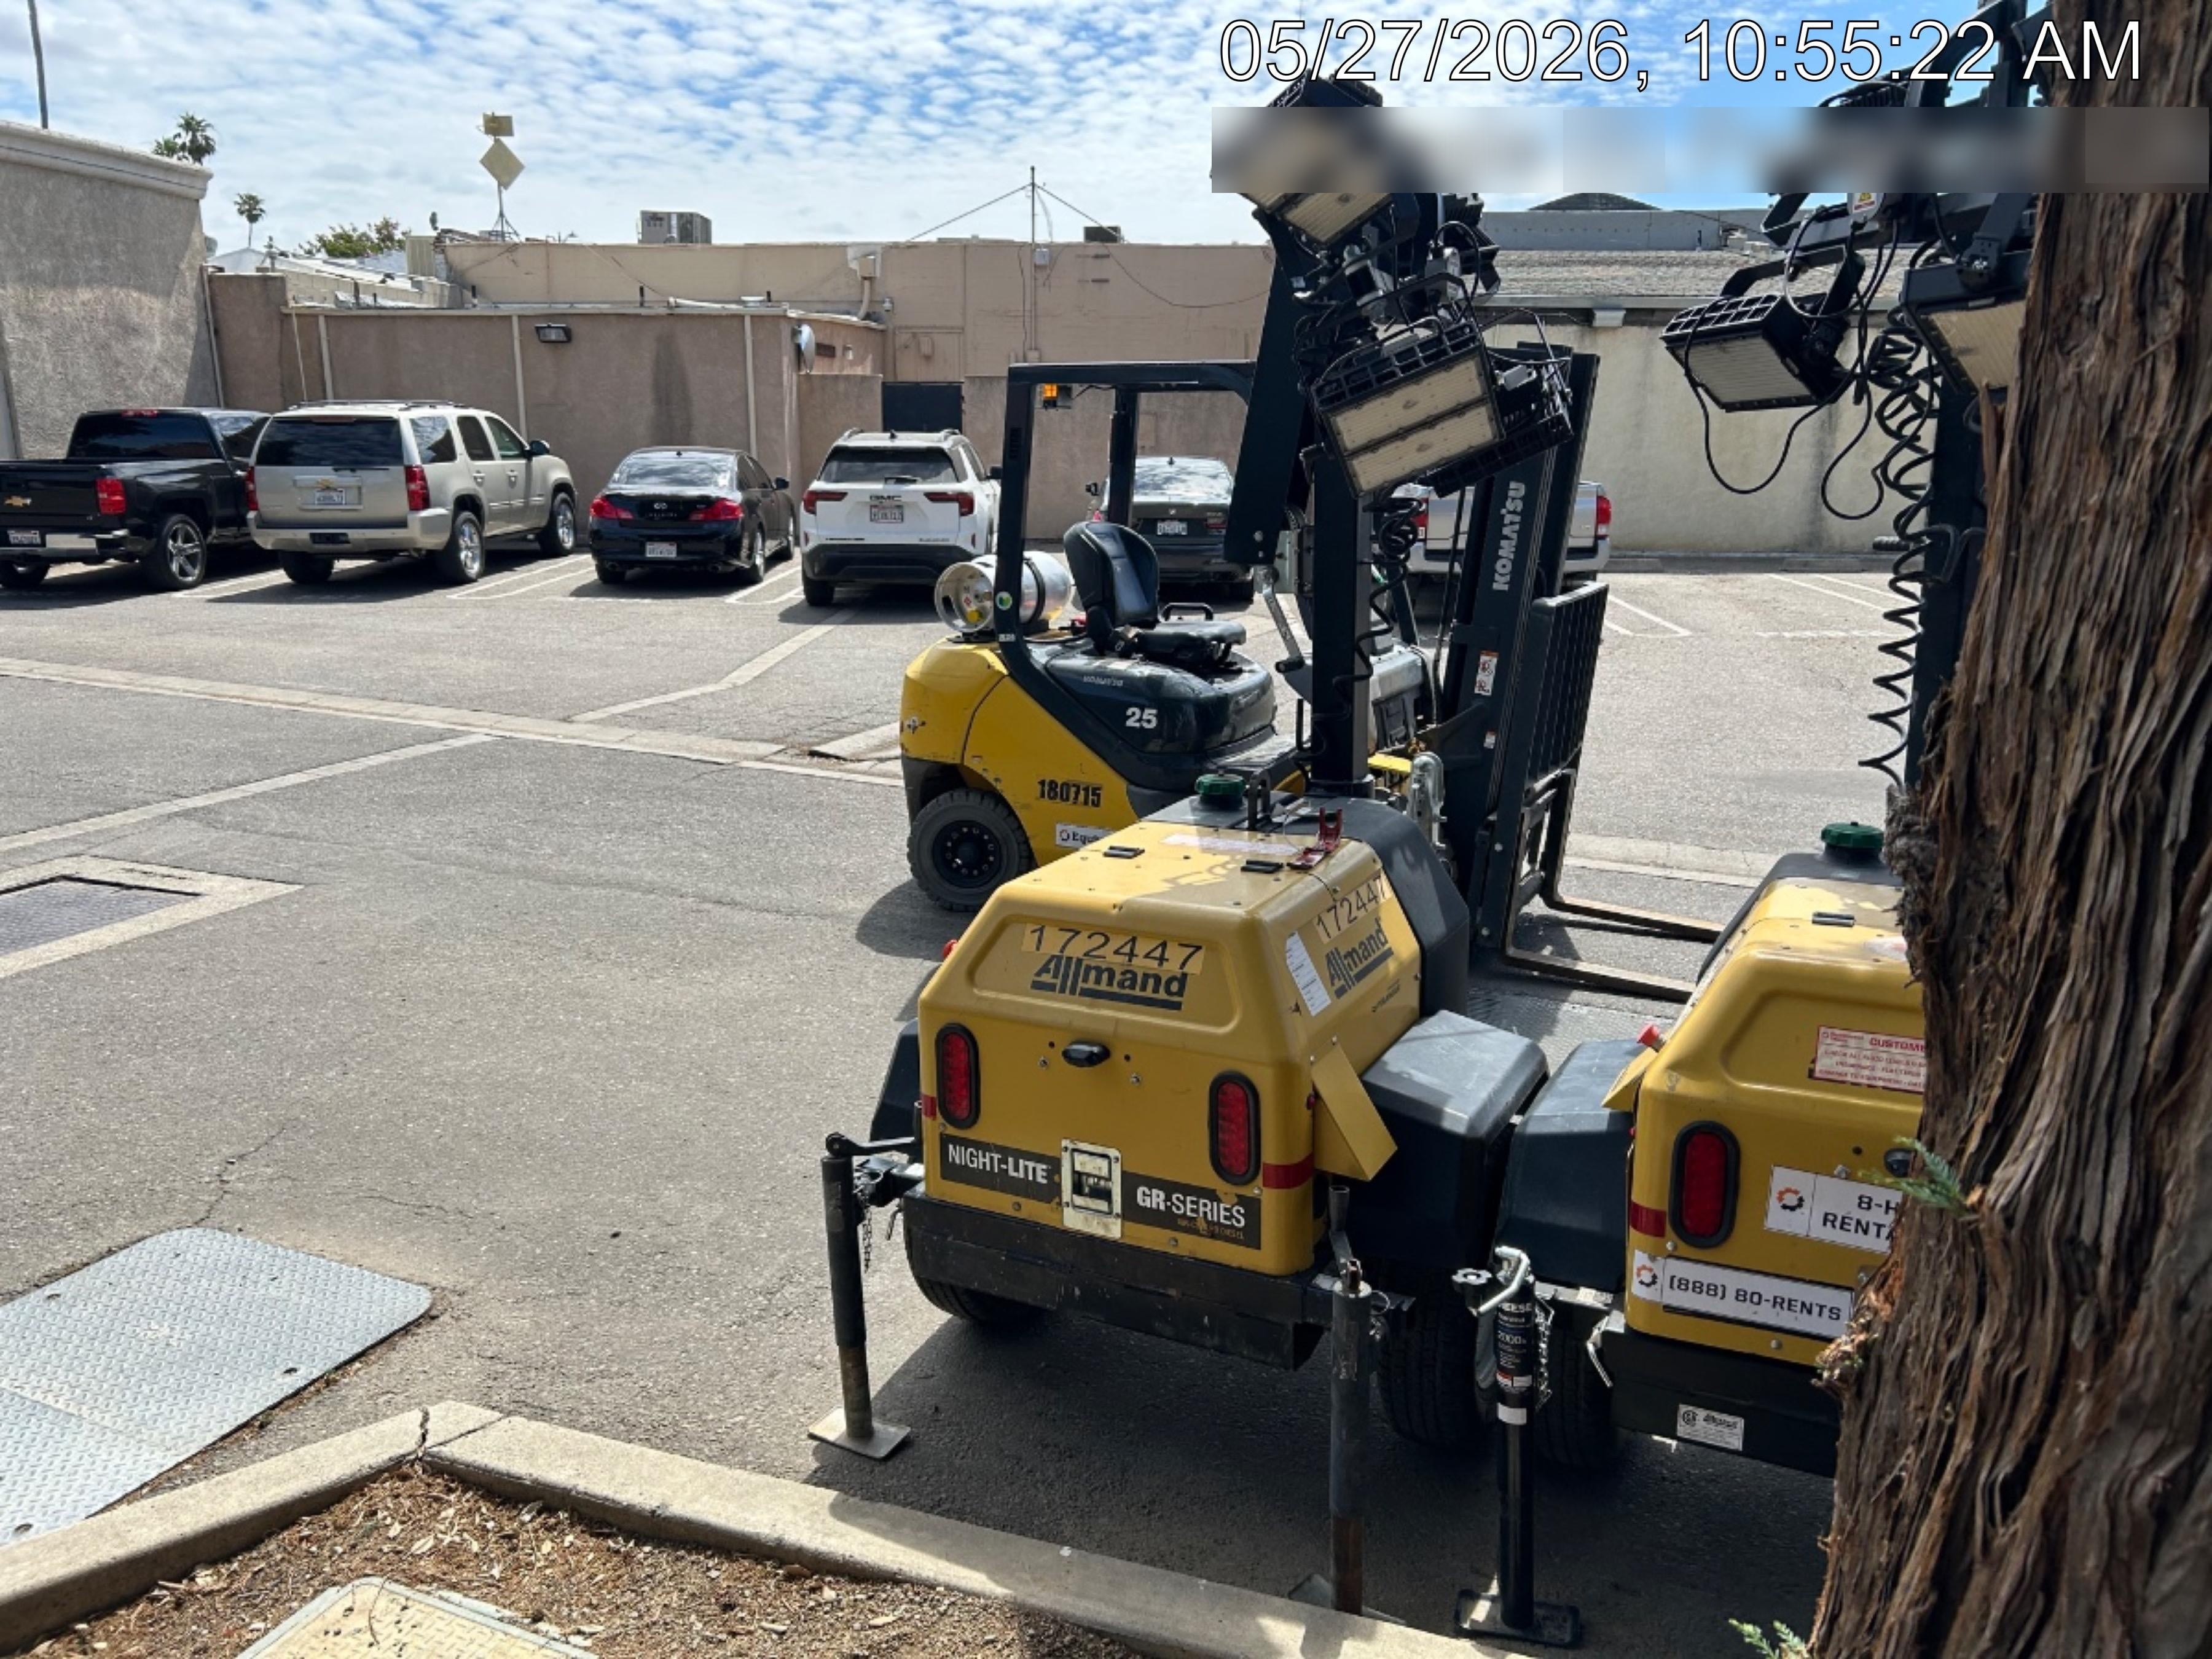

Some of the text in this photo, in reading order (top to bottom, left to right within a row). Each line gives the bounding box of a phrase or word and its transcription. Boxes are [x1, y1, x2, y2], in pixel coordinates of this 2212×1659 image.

[1492, 480, 1526, 591] KOMATSU
[1125, 707, 1158, 729] 25
[1037, 779, 1102, 807] 180715
[1316, 873, 1386, 939] 172447
[1030, 924, 1202, 970] 172447
[1325, 917, 1389, 990] Allmand
[1032, 954, 1188, 998] Allmand
[948, 1143, 1048, 1185] NIGHT-LITE
[1669, 1274, 1726, 1301] (888)
